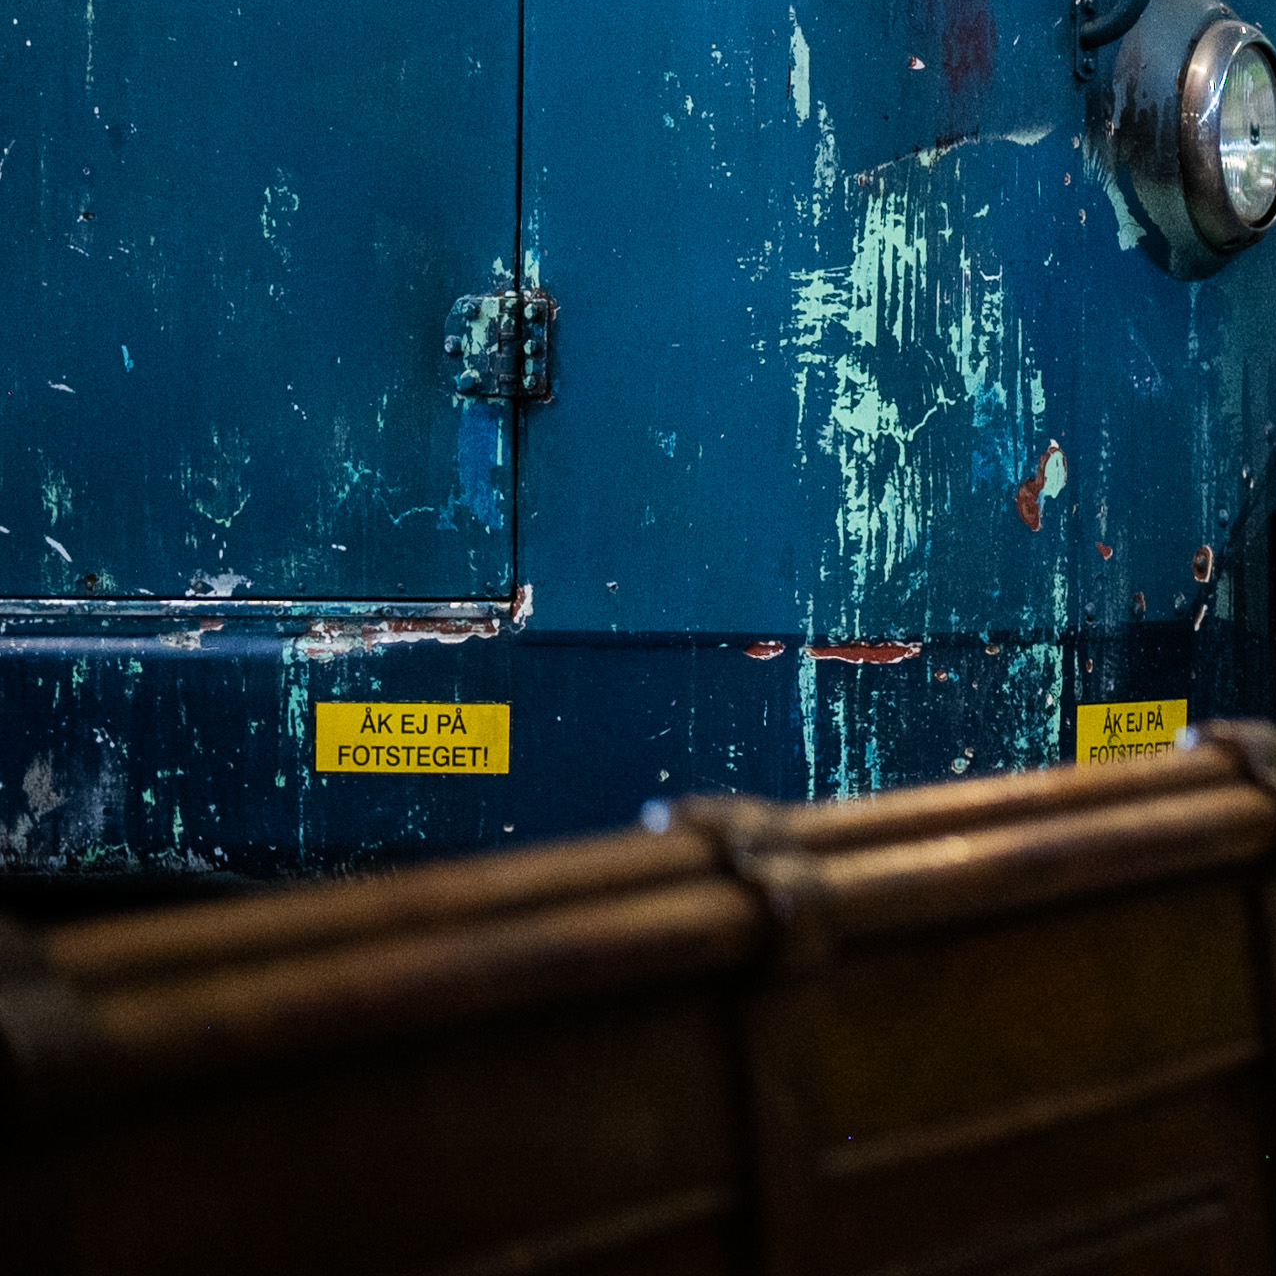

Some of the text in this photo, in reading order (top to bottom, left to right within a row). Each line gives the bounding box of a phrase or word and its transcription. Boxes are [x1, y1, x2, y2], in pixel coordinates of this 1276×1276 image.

[359, 706, 468, 735] ÅK EJ PÅ
[1102, 704, 1164, 734] ÅK EJ PÅ
[337, 744, 489, 768] FOTSTEGET!
